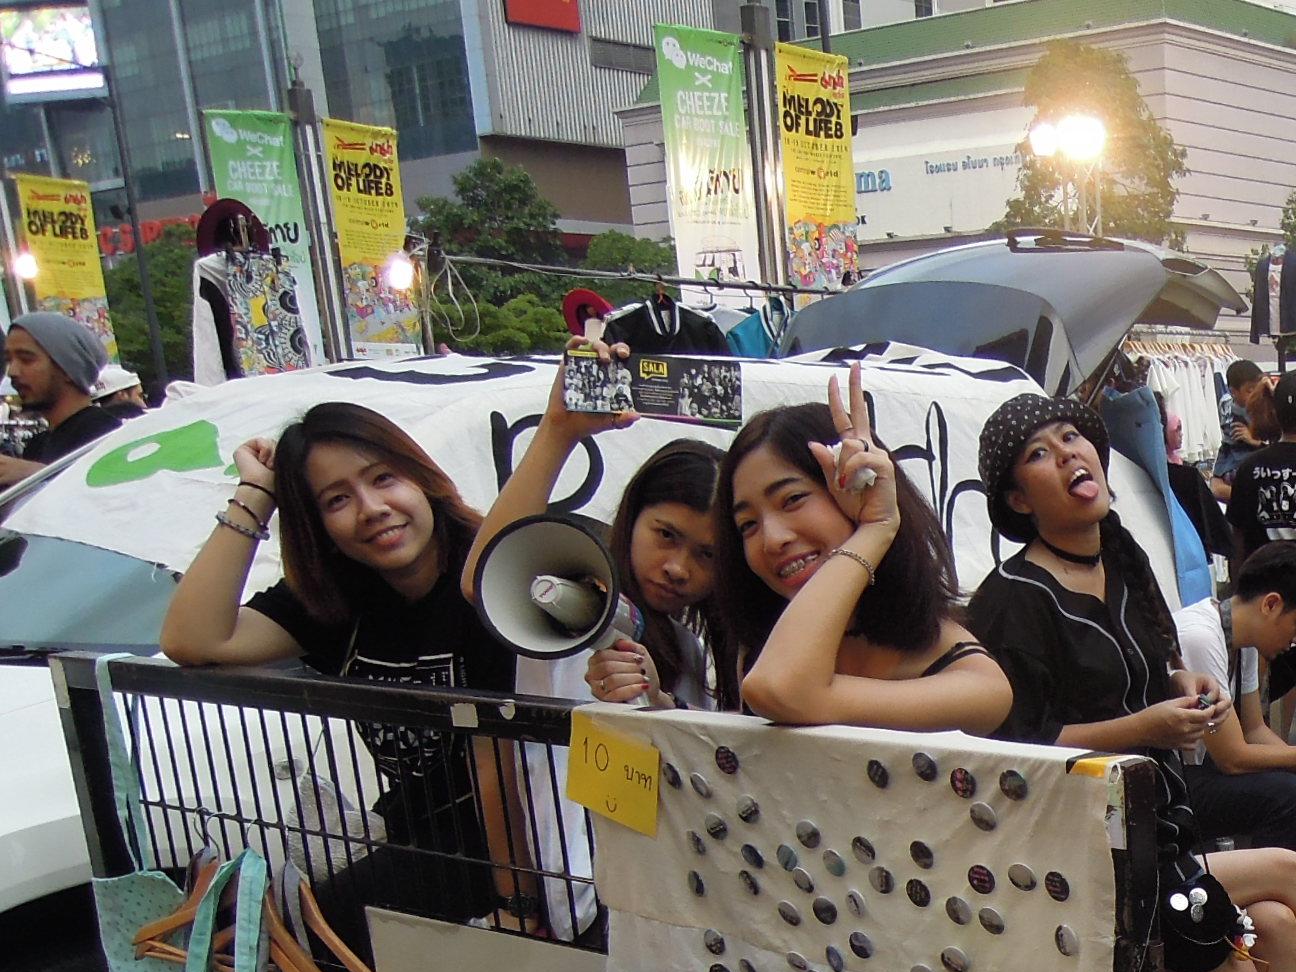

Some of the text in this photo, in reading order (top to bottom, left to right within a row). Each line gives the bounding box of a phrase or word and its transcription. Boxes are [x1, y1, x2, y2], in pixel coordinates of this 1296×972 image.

[687, 51, 733, 75] WeChat
[676, 90, 729, 116] CHEEZE
[783, 90, 844, 120] MELODY
[783, 110, 802, 133] OF
[238, 129, 284, 148] WeChat
[228, 160, 281, 180] CHEEZE
[333, 157, 393, 181] MELODY
[333, 173, 353, 192] OF
[27, 207, 87, 226] MELODY
[28, 220, 49, 236] OF
[583, 736, 653, 791] 10 บาท
